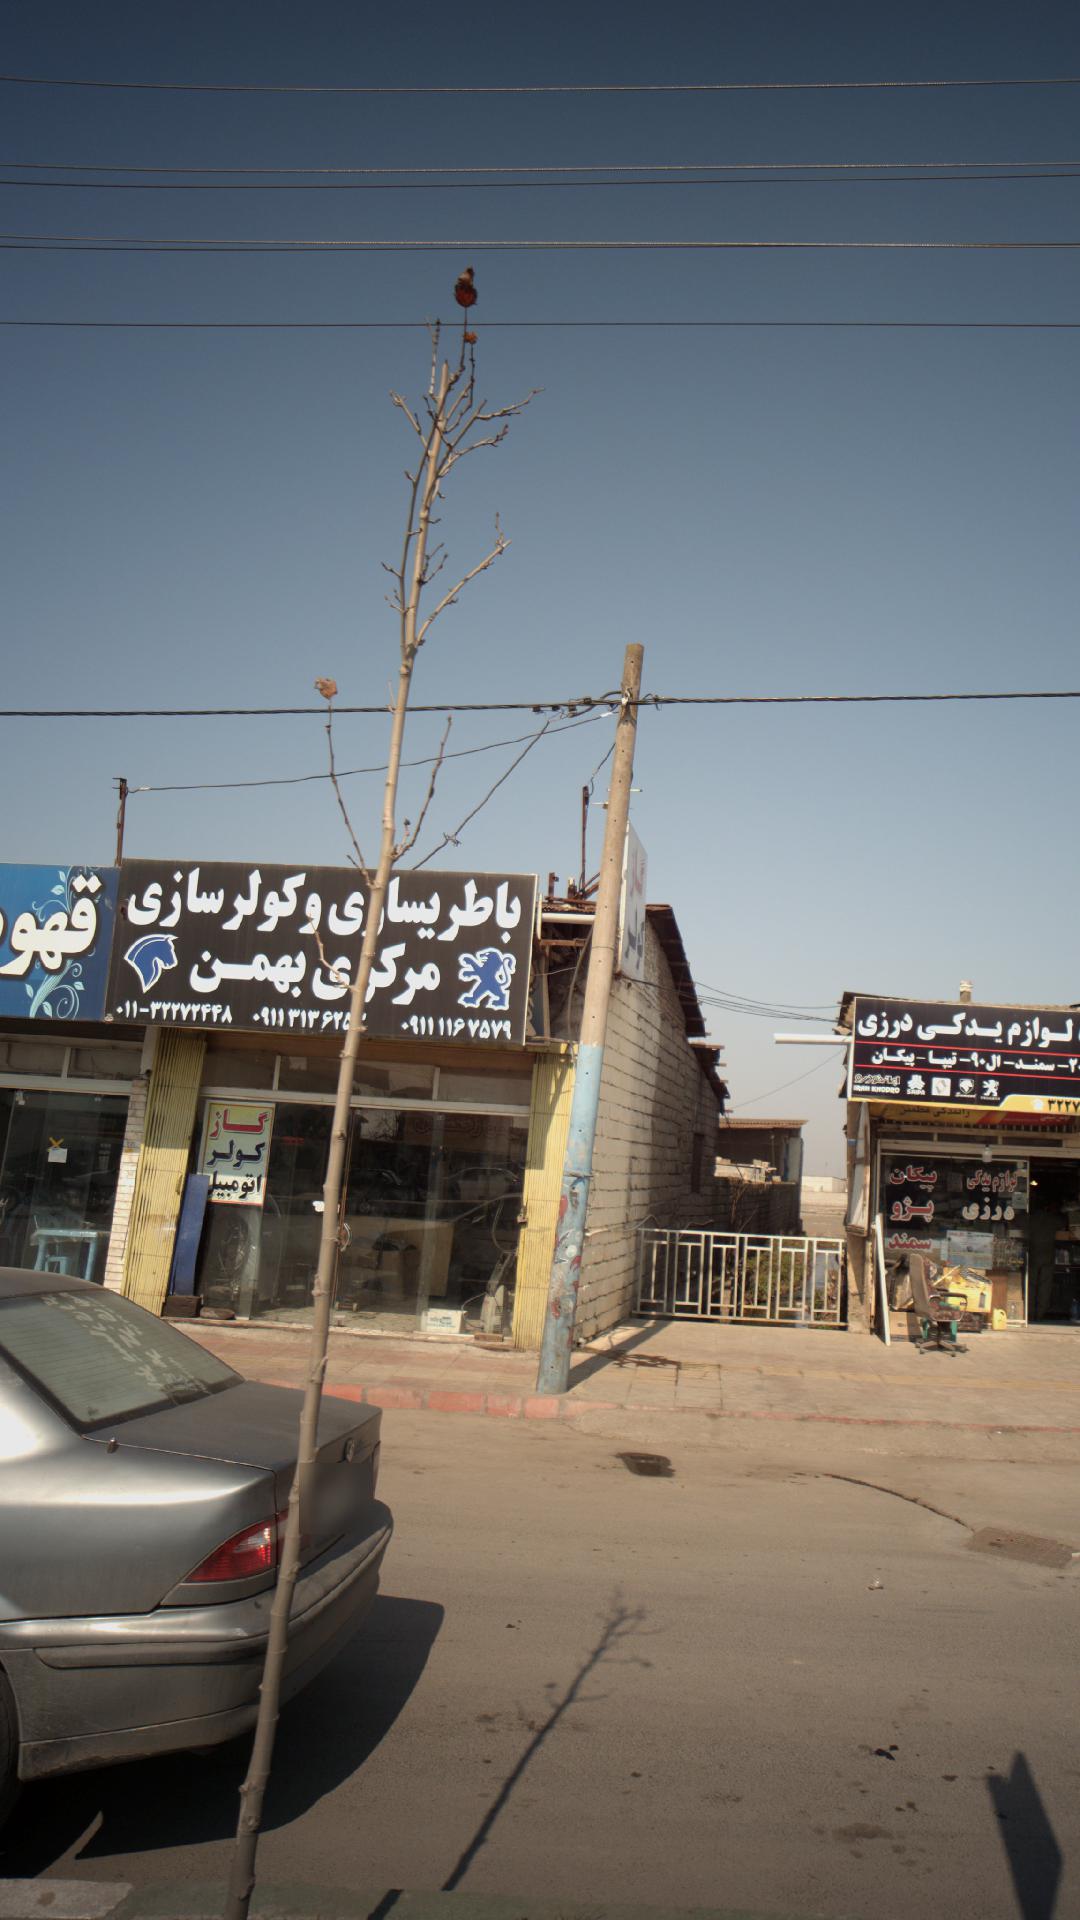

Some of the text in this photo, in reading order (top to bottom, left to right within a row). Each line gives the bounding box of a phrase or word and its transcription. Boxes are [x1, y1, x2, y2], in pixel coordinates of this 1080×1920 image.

[0, 874, 102, 976] قهو
[189, 950, 307, 998] بهمن
[858, 1012, 913, 1038] درزی
[917, 1012, 1002, 1043] یدکی
[1008, 1016, 1073, 1048] لوازم
[872, 1047, 915, 1067] پیکان
[1014, 1058, 1055, 1071] سمند
[209, 1109, 269, 1138] گاز
[207, 1140, 265, 1168] کولر
[890, 1165, 937, 1192] پیکان
[890, 1196, 934, 1222] پژو
[888, 1232, 932, 1251] سمند
